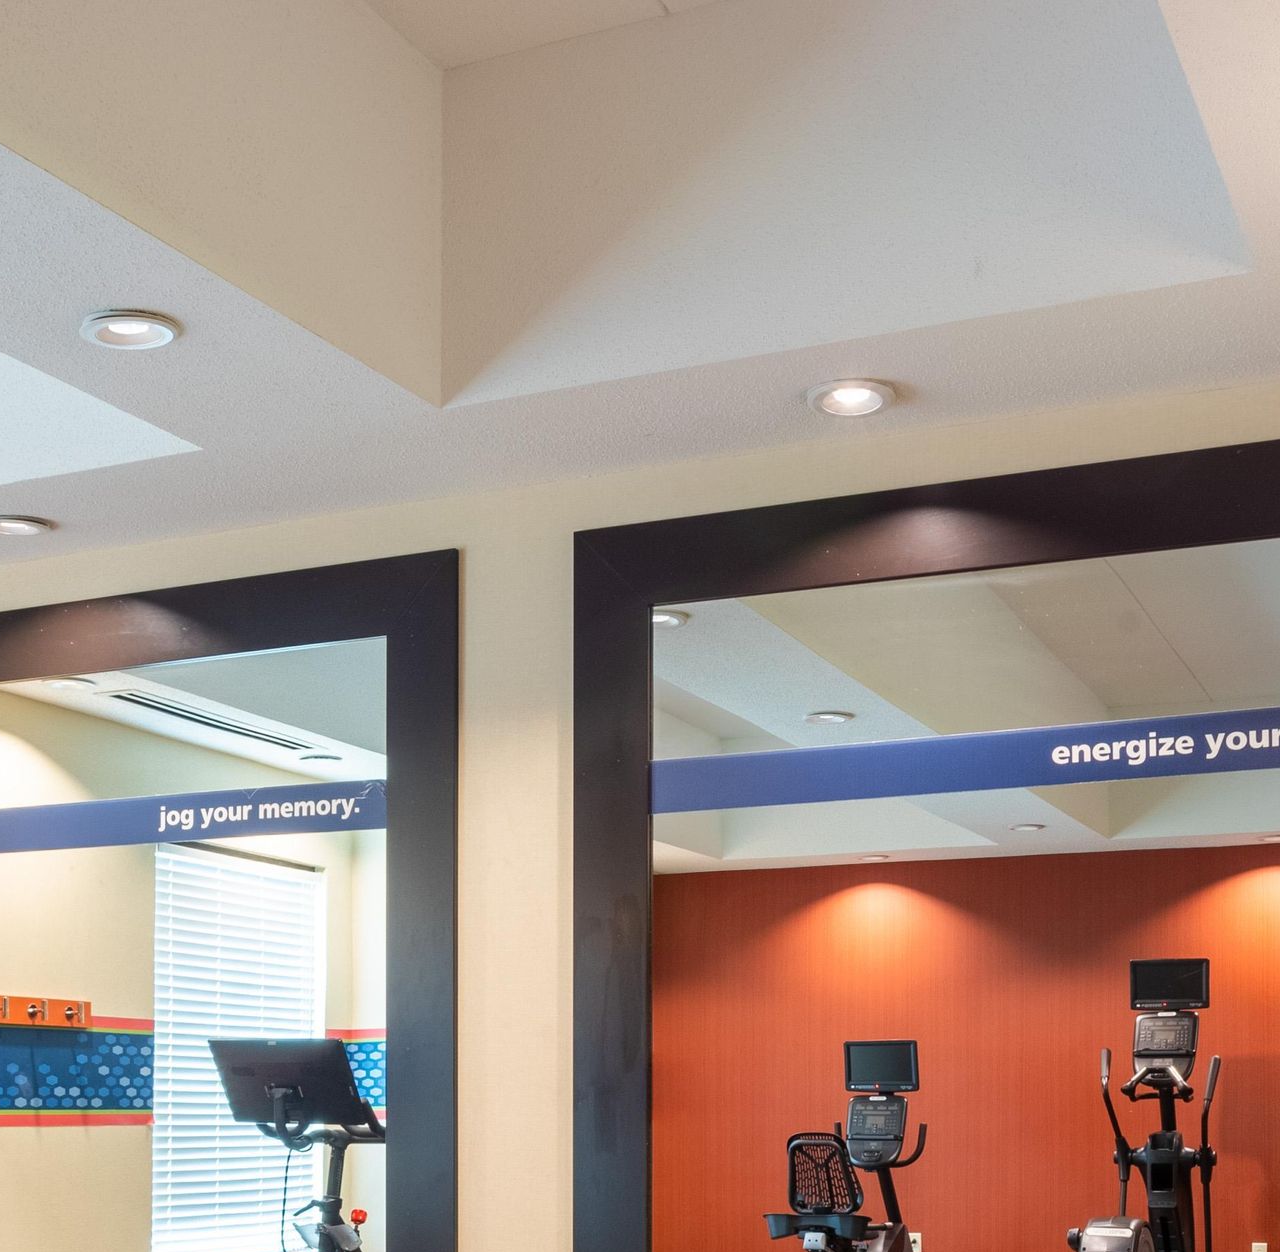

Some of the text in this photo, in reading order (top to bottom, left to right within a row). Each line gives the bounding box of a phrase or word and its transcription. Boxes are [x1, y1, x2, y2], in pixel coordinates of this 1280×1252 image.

[1051, 732, 1195, 765] energize
[158, 797, 360, 832] jog your memory.
